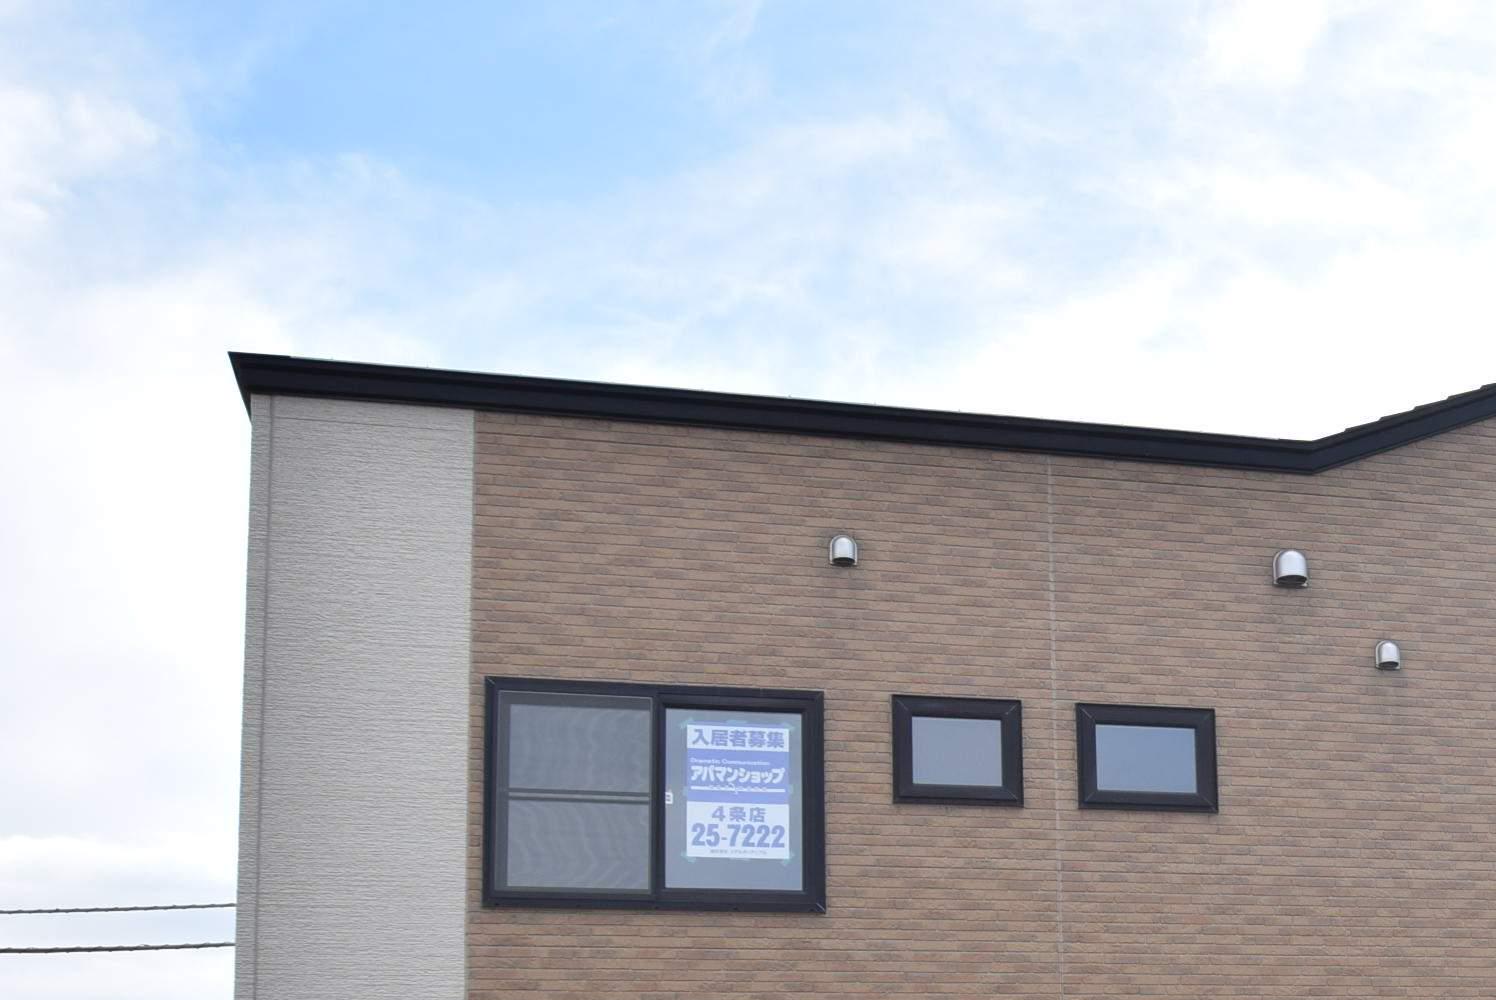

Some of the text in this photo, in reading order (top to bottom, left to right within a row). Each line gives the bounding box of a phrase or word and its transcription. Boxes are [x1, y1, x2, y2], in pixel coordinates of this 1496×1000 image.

[691, 729, 784, 748] 入居者募集
[690, 765, 786, 784] アパマンショップ
[691, 822, 785, 849] 25-7222
